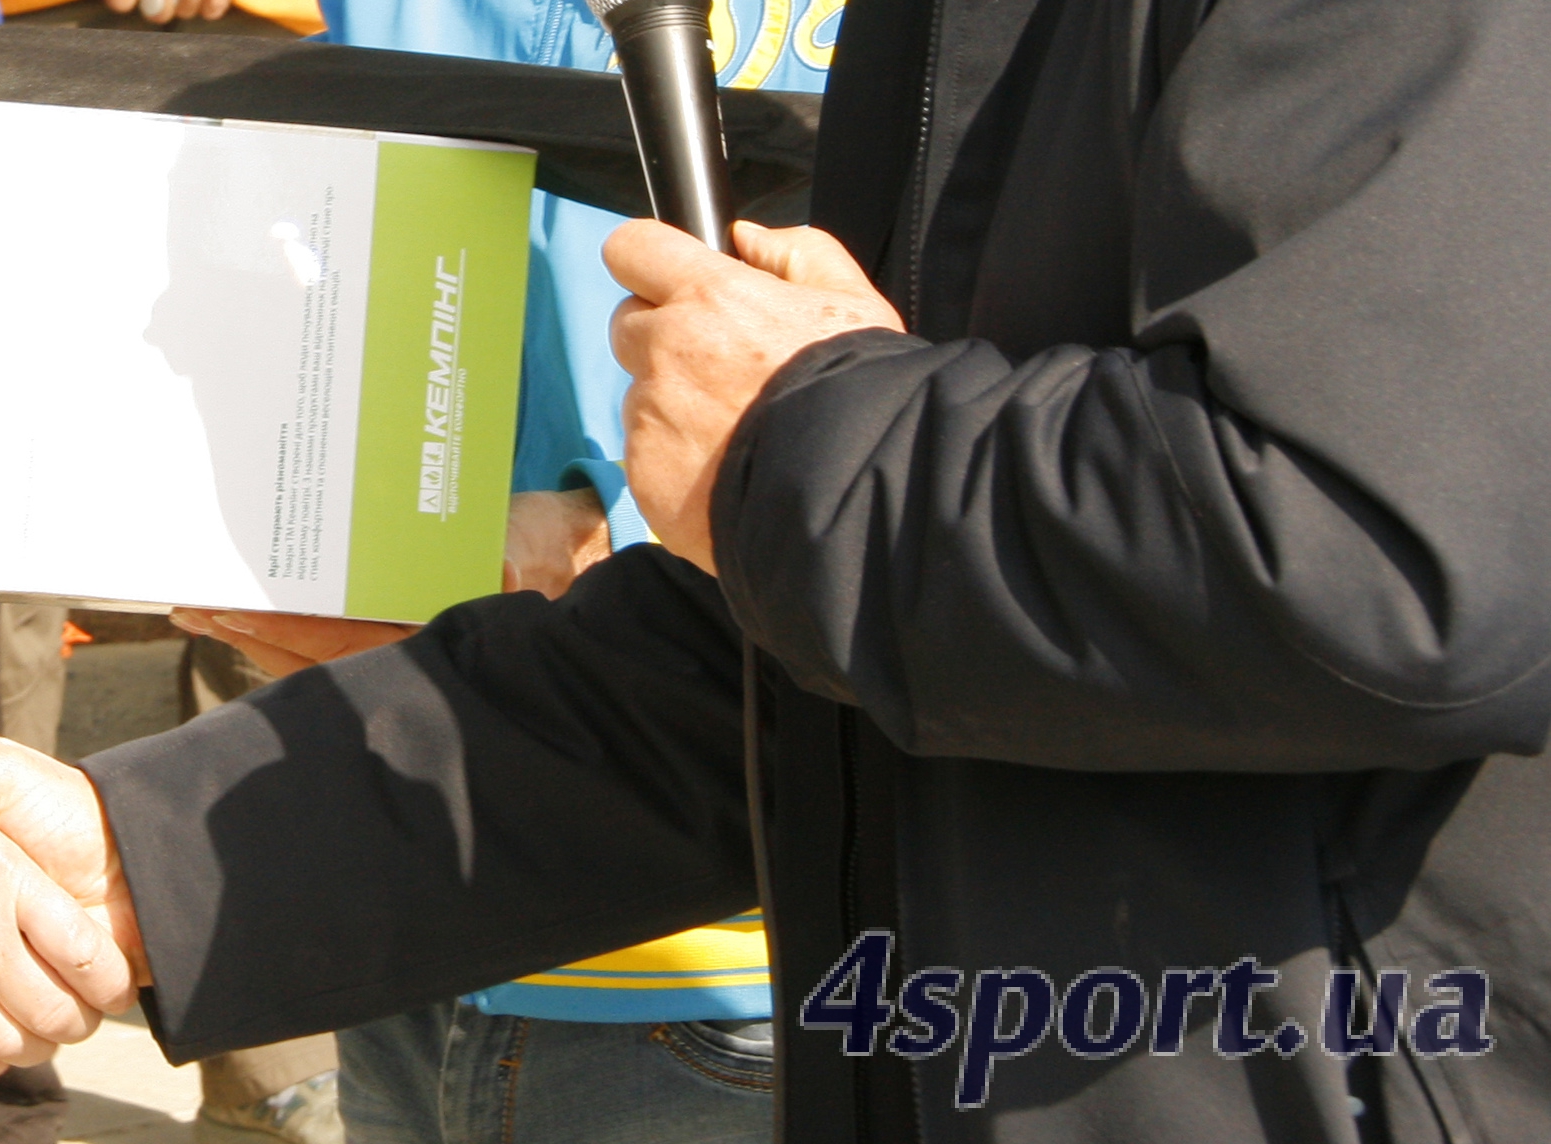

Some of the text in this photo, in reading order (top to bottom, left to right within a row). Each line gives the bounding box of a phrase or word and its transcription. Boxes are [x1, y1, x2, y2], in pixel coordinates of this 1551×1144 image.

[424, 255, 459, 438] КЕМПІНГ
[454, 367, 468, 432] КОМФОРТНО
[271, 494, 283, 553] створюють
